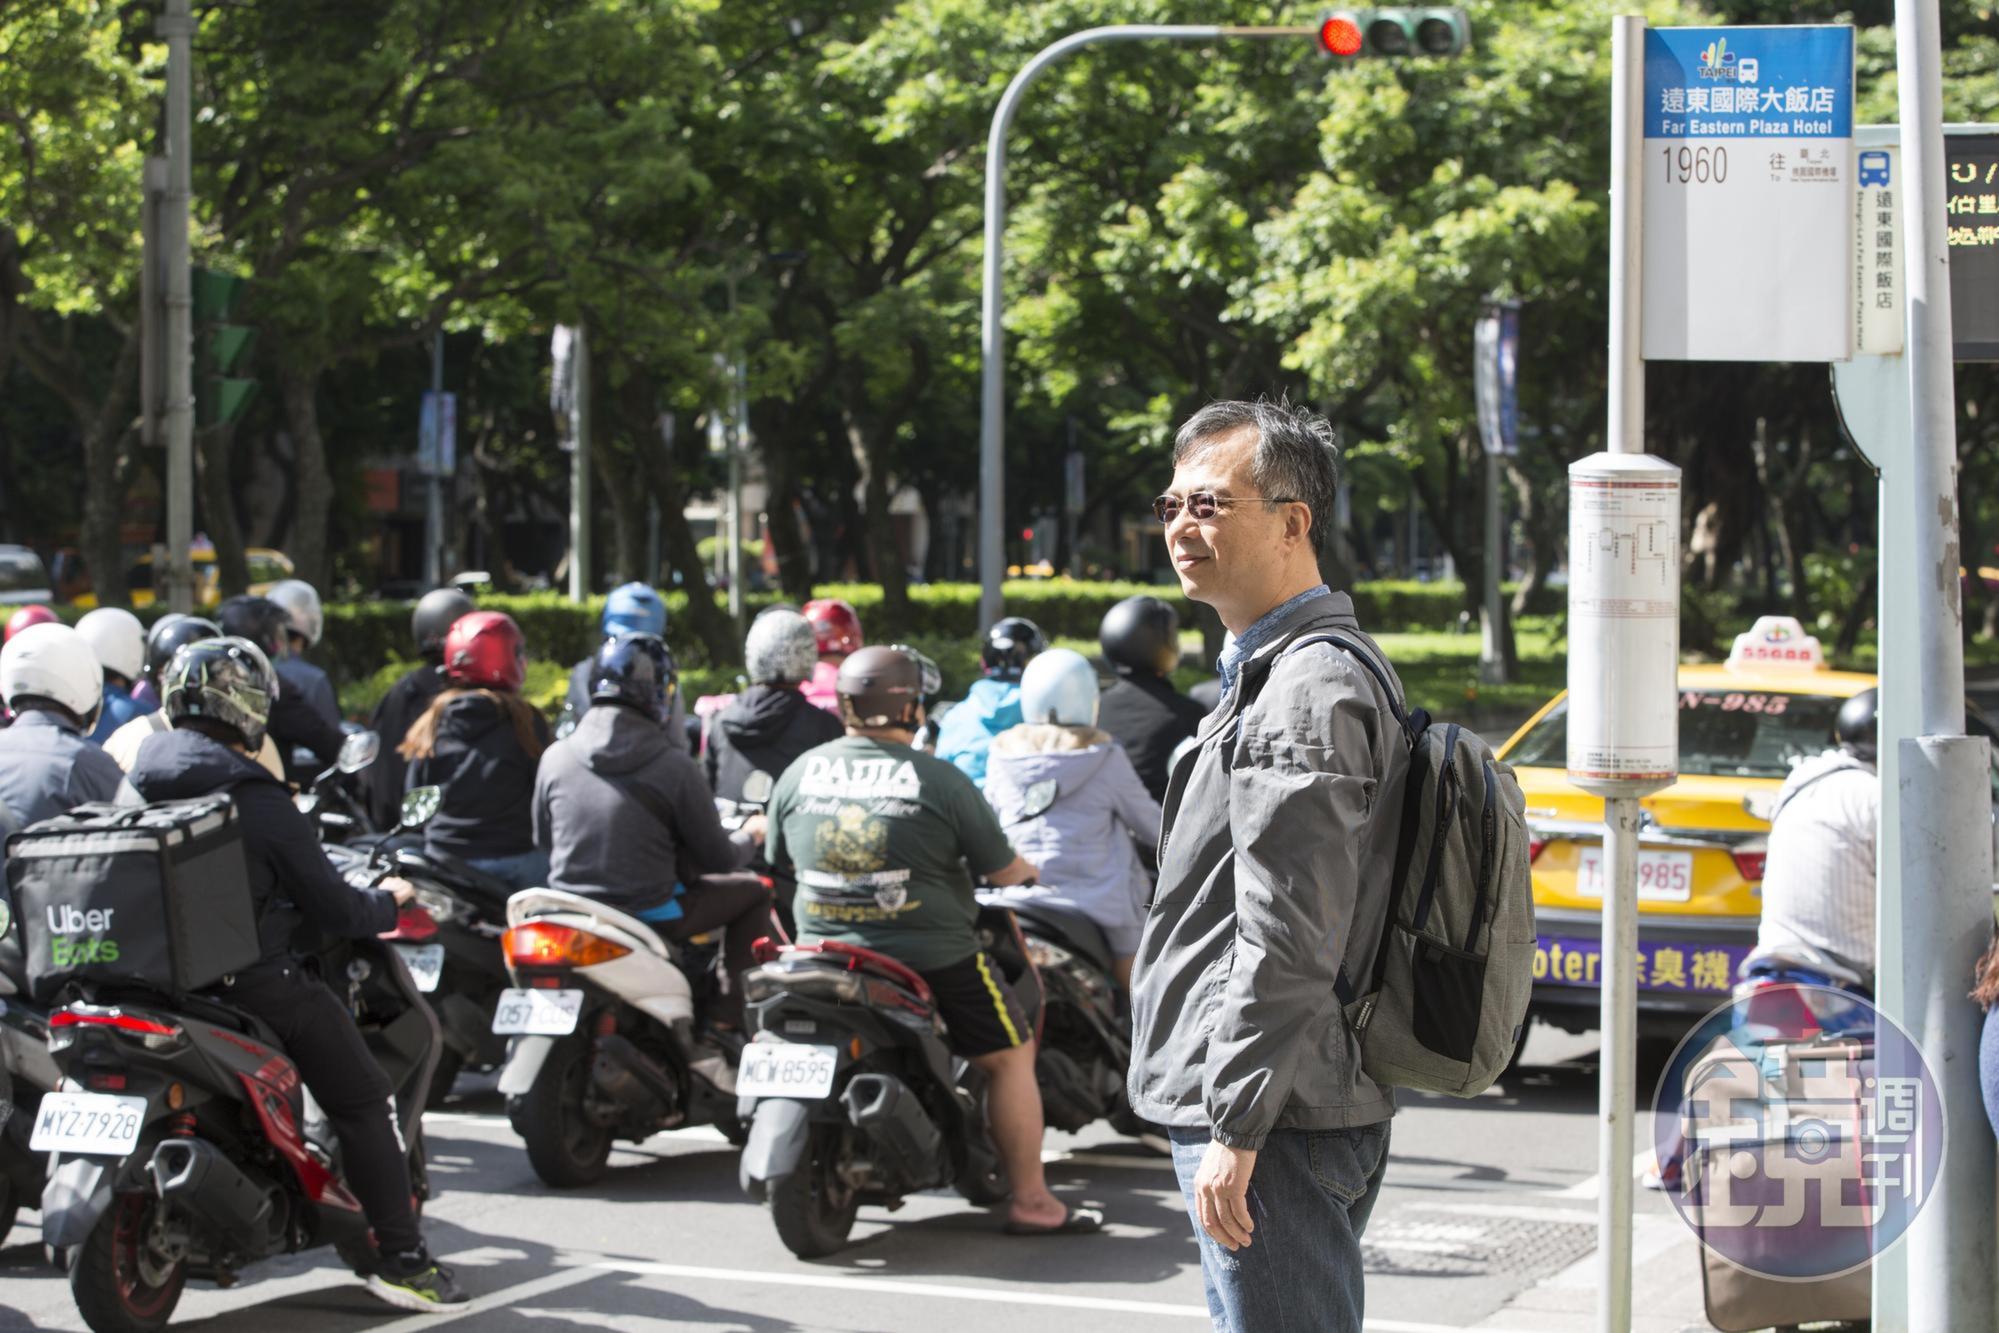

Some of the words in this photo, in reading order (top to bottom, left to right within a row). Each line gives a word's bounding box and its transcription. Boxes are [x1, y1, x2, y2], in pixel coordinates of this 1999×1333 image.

[1698, 66, 1737, 79] TAIPEI
[1661, 86, 1835, 113] 遠東國際大飯店
[1662, 120, 1685, 134] Far
[1690, 120, 1745, 134] Eastern
[1750, 120, 1789, 134] Plaza
[1793, 120, 1832, 134] Hotel
[1663, 146, 1727, 184] 1960
[1769, 152, 1786, 170] 往
[1876, 191, 1893, 309] 遠東國際飯店
[47, 904, 114, 934] Uber
[51, 935, 120, 966] Eats
